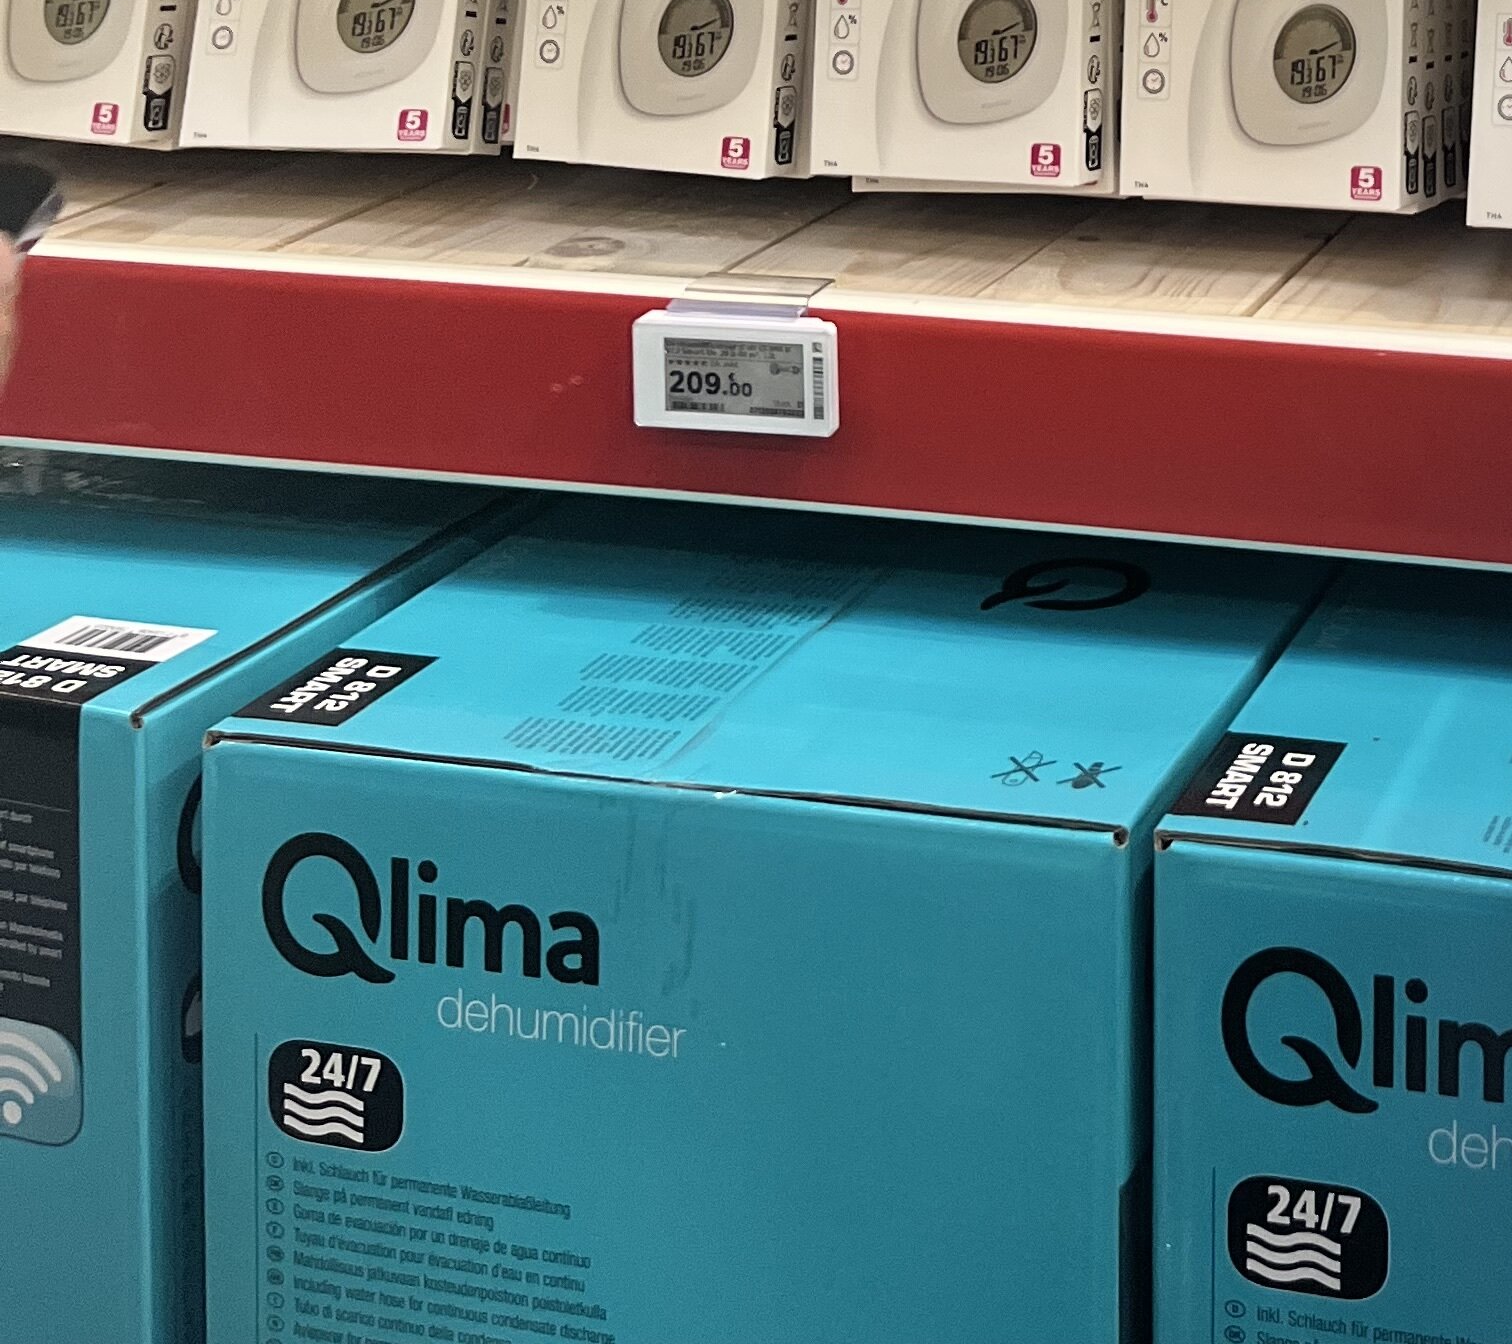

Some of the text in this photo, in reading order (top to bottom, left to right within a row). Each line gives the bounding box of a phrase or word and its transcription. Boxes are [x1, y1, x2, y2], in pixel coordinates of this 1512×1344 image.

[99, 103, 113, 123] 5
[405, 110, 421, 130] 5
[727, 137, 744, 158] 5
[1038, 144, 1055, 165] 5
[1358, 167, 1375, 188] 5
[269, 657, 368, 713] SMART
[313, 665, 402, 712] D 812
[1205, 743, 1275, 810] SMART
[1253, 752, 1316, 807] D 812
[261, 831, 600, 986] Qlima
[436, 987, 686, 1058] dehumidifier
[300, 1047, 381, 1092] 24/7
[1266, 1184, 1361, 1234] 24/7
